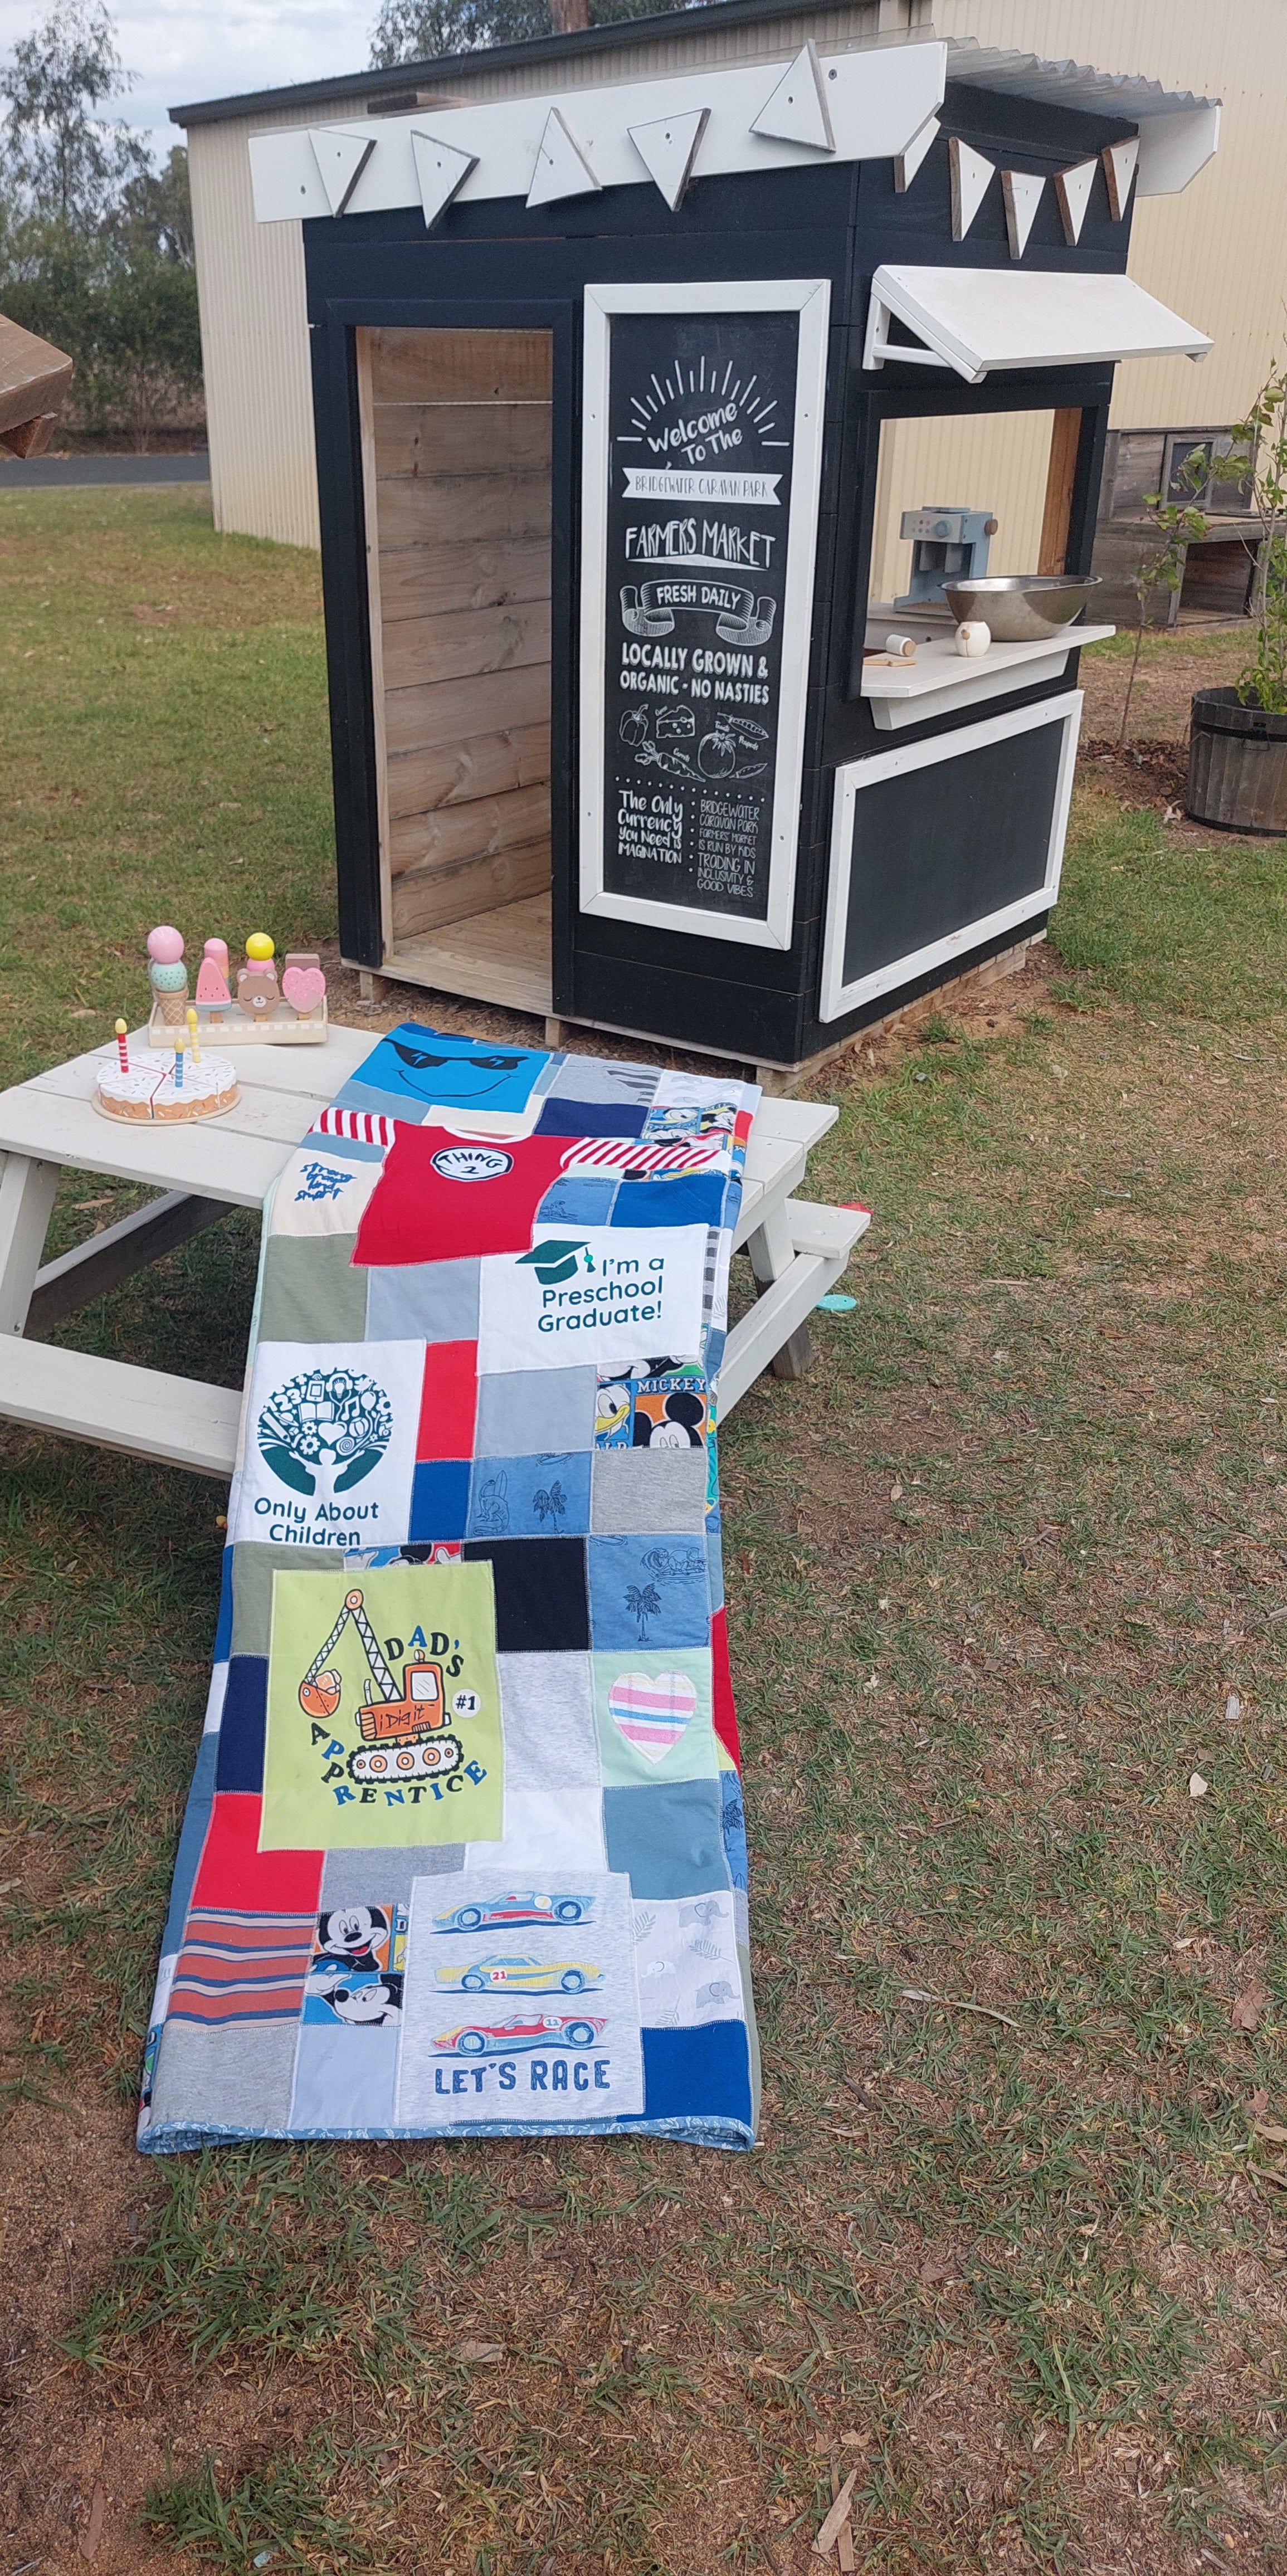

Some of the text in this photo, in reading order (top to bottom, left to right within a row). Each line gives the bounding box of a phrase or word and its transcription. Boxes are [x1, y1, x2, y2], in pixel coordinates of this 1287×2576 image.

[647, 402, 738, 453] Welcome
[681, 428, 743, 465] To The
[635, 476, 768, 498] BRIDGEWATER CARAVAN PARK
[625, 518, 776, 568] FARMERS MARKET
[656, 585, 742, 610] FRESH DAILY
[621, 642, 769, 679] LOCALLY GROWN &
[620, 670, 680, 695] ORGANIC
[691, 679, 712, 699] NO
[714, 680, 770, 705] NASTIES
[618, 789, 683, 822] The Only
[617, 808, 682, 839] Currency
[641, 829, 671, 848] Need
[698, 838, 756, 859] IS RUN BY KIDS
[732, 832, 758, 846] MARKET
[697, 852, 755, 875] TRADING IN
[697, 878, 753, 897] GOOD VIBES
[747, 875, 755, 886] &
[437, 1152, 504, 1168] THING
[603, 1258, 665, 1276] I'm a
[543, 1275, 663, 1309] Preschool
[538, 1301, 662, 1333] Graduate!
[637, 1378, 706, 1393] MICKEY
[254, 1497, 379, 1524] Only About
[270, 1525, 361, 1546] Children
[383, 1625, 465, 1678] DAD'S
[455, 1694, 477, 1710] #1
[309, 1722, 488, 1807] APPRENTICE
[539, 1897, 547, 1908] 7
[492, 1970, 506, 1980] 21
[435, 2059, 611, 2095] LET'S RACE
